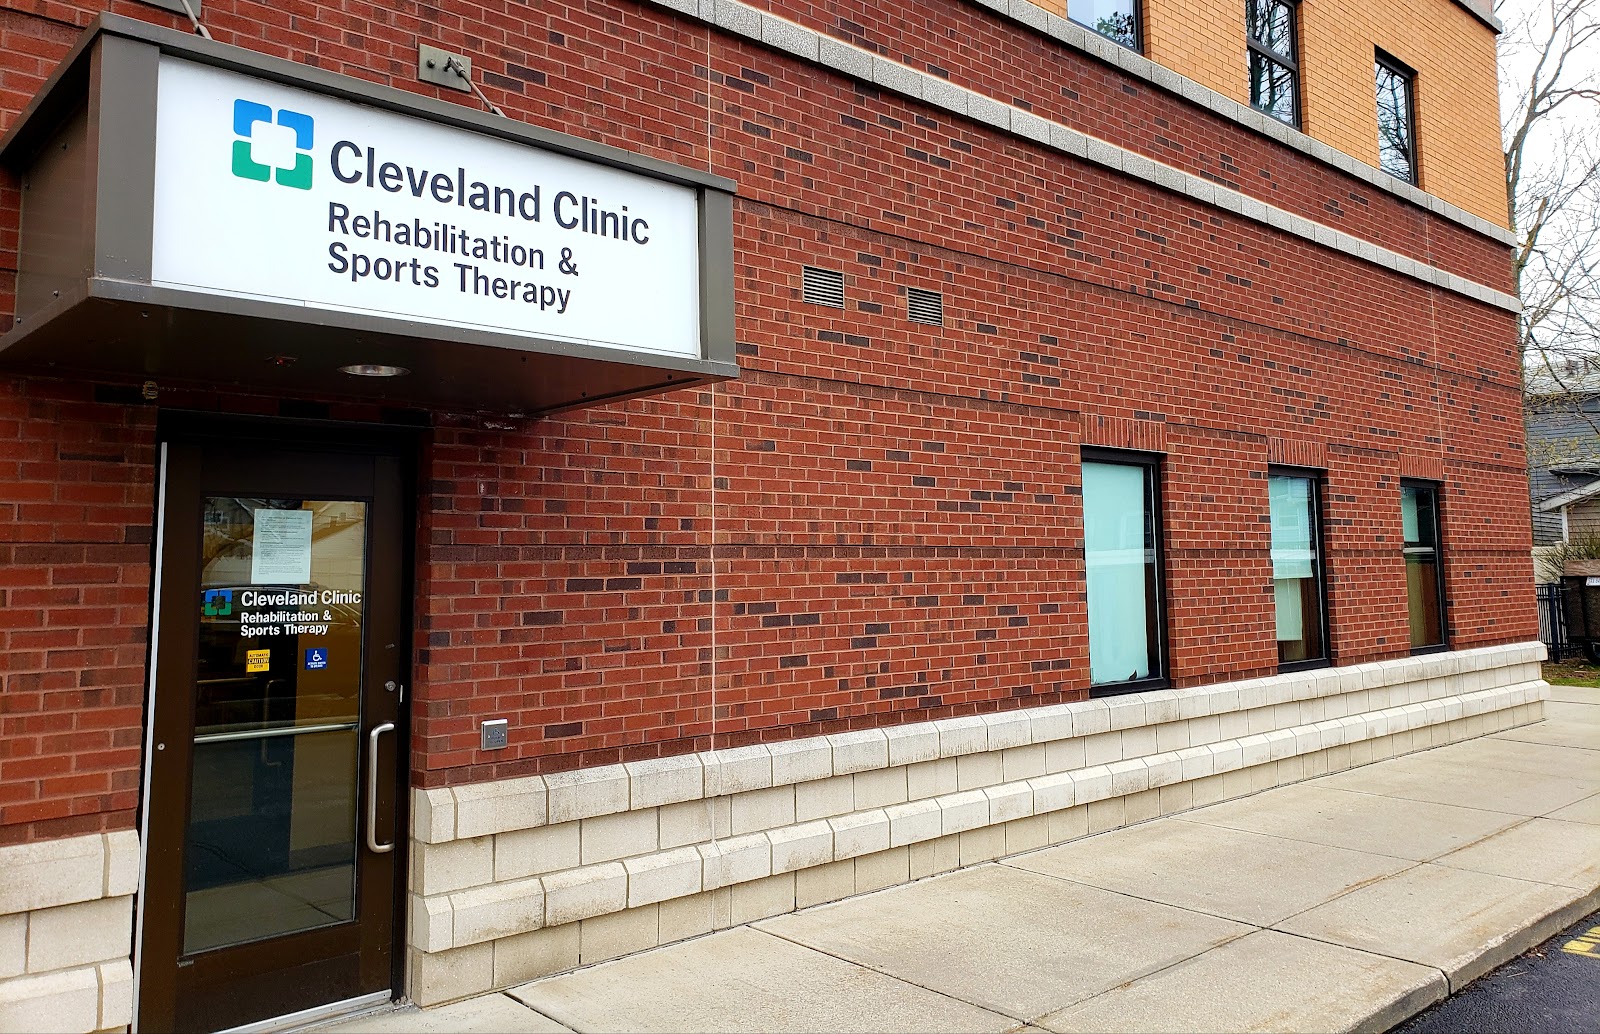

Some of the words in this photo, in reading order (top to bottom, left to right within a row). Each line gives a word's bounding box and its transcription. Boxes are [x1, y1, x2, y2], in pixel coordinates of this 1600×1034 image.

[330, 140, 541, 222] Cleveland
[553, 191, 650, 245] Clinic
[328, 201, 544, 270] Rehabilitation
[558, 247, 579, 276] &
[328, 242, 440, 288] Sports
[454, 263, 571, 314] Therapy
[240, 611, 319, 623] Rehabilitation
[323, 610, 332, 621] &
[241, 591, 317, 607] Cleveland
[321, 590, 362, 605] Clinic
[240, 625, 280, 638] Sports
[284, 624, 328, 635] Therapy
